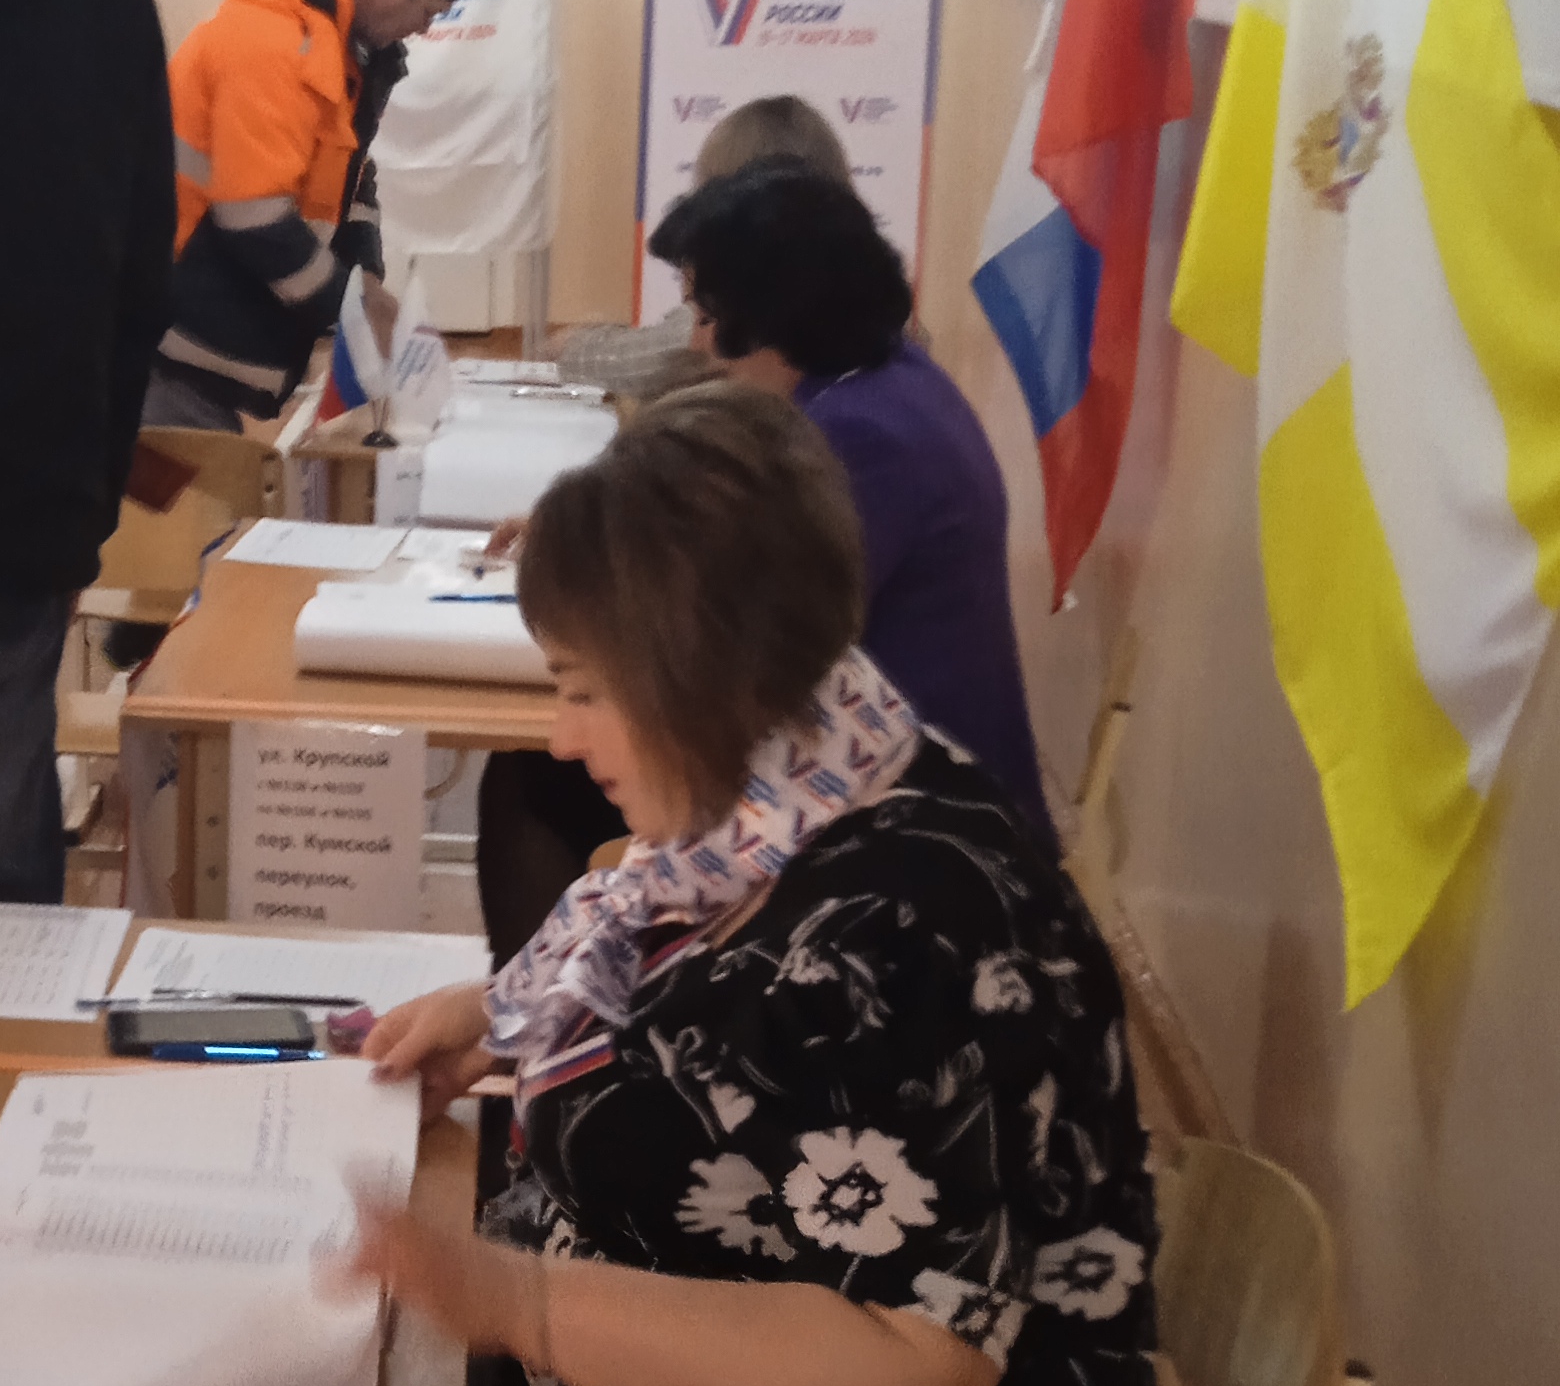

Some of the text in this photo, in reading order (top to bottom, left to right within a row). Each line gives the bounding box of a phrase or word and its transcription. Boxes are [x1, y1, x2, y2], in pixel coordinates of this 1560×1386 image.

[764, 3, 845, 24] РОССИИ
[293, 747, 389, 770] Крупской
[254, 902, 326, 922] проезд
